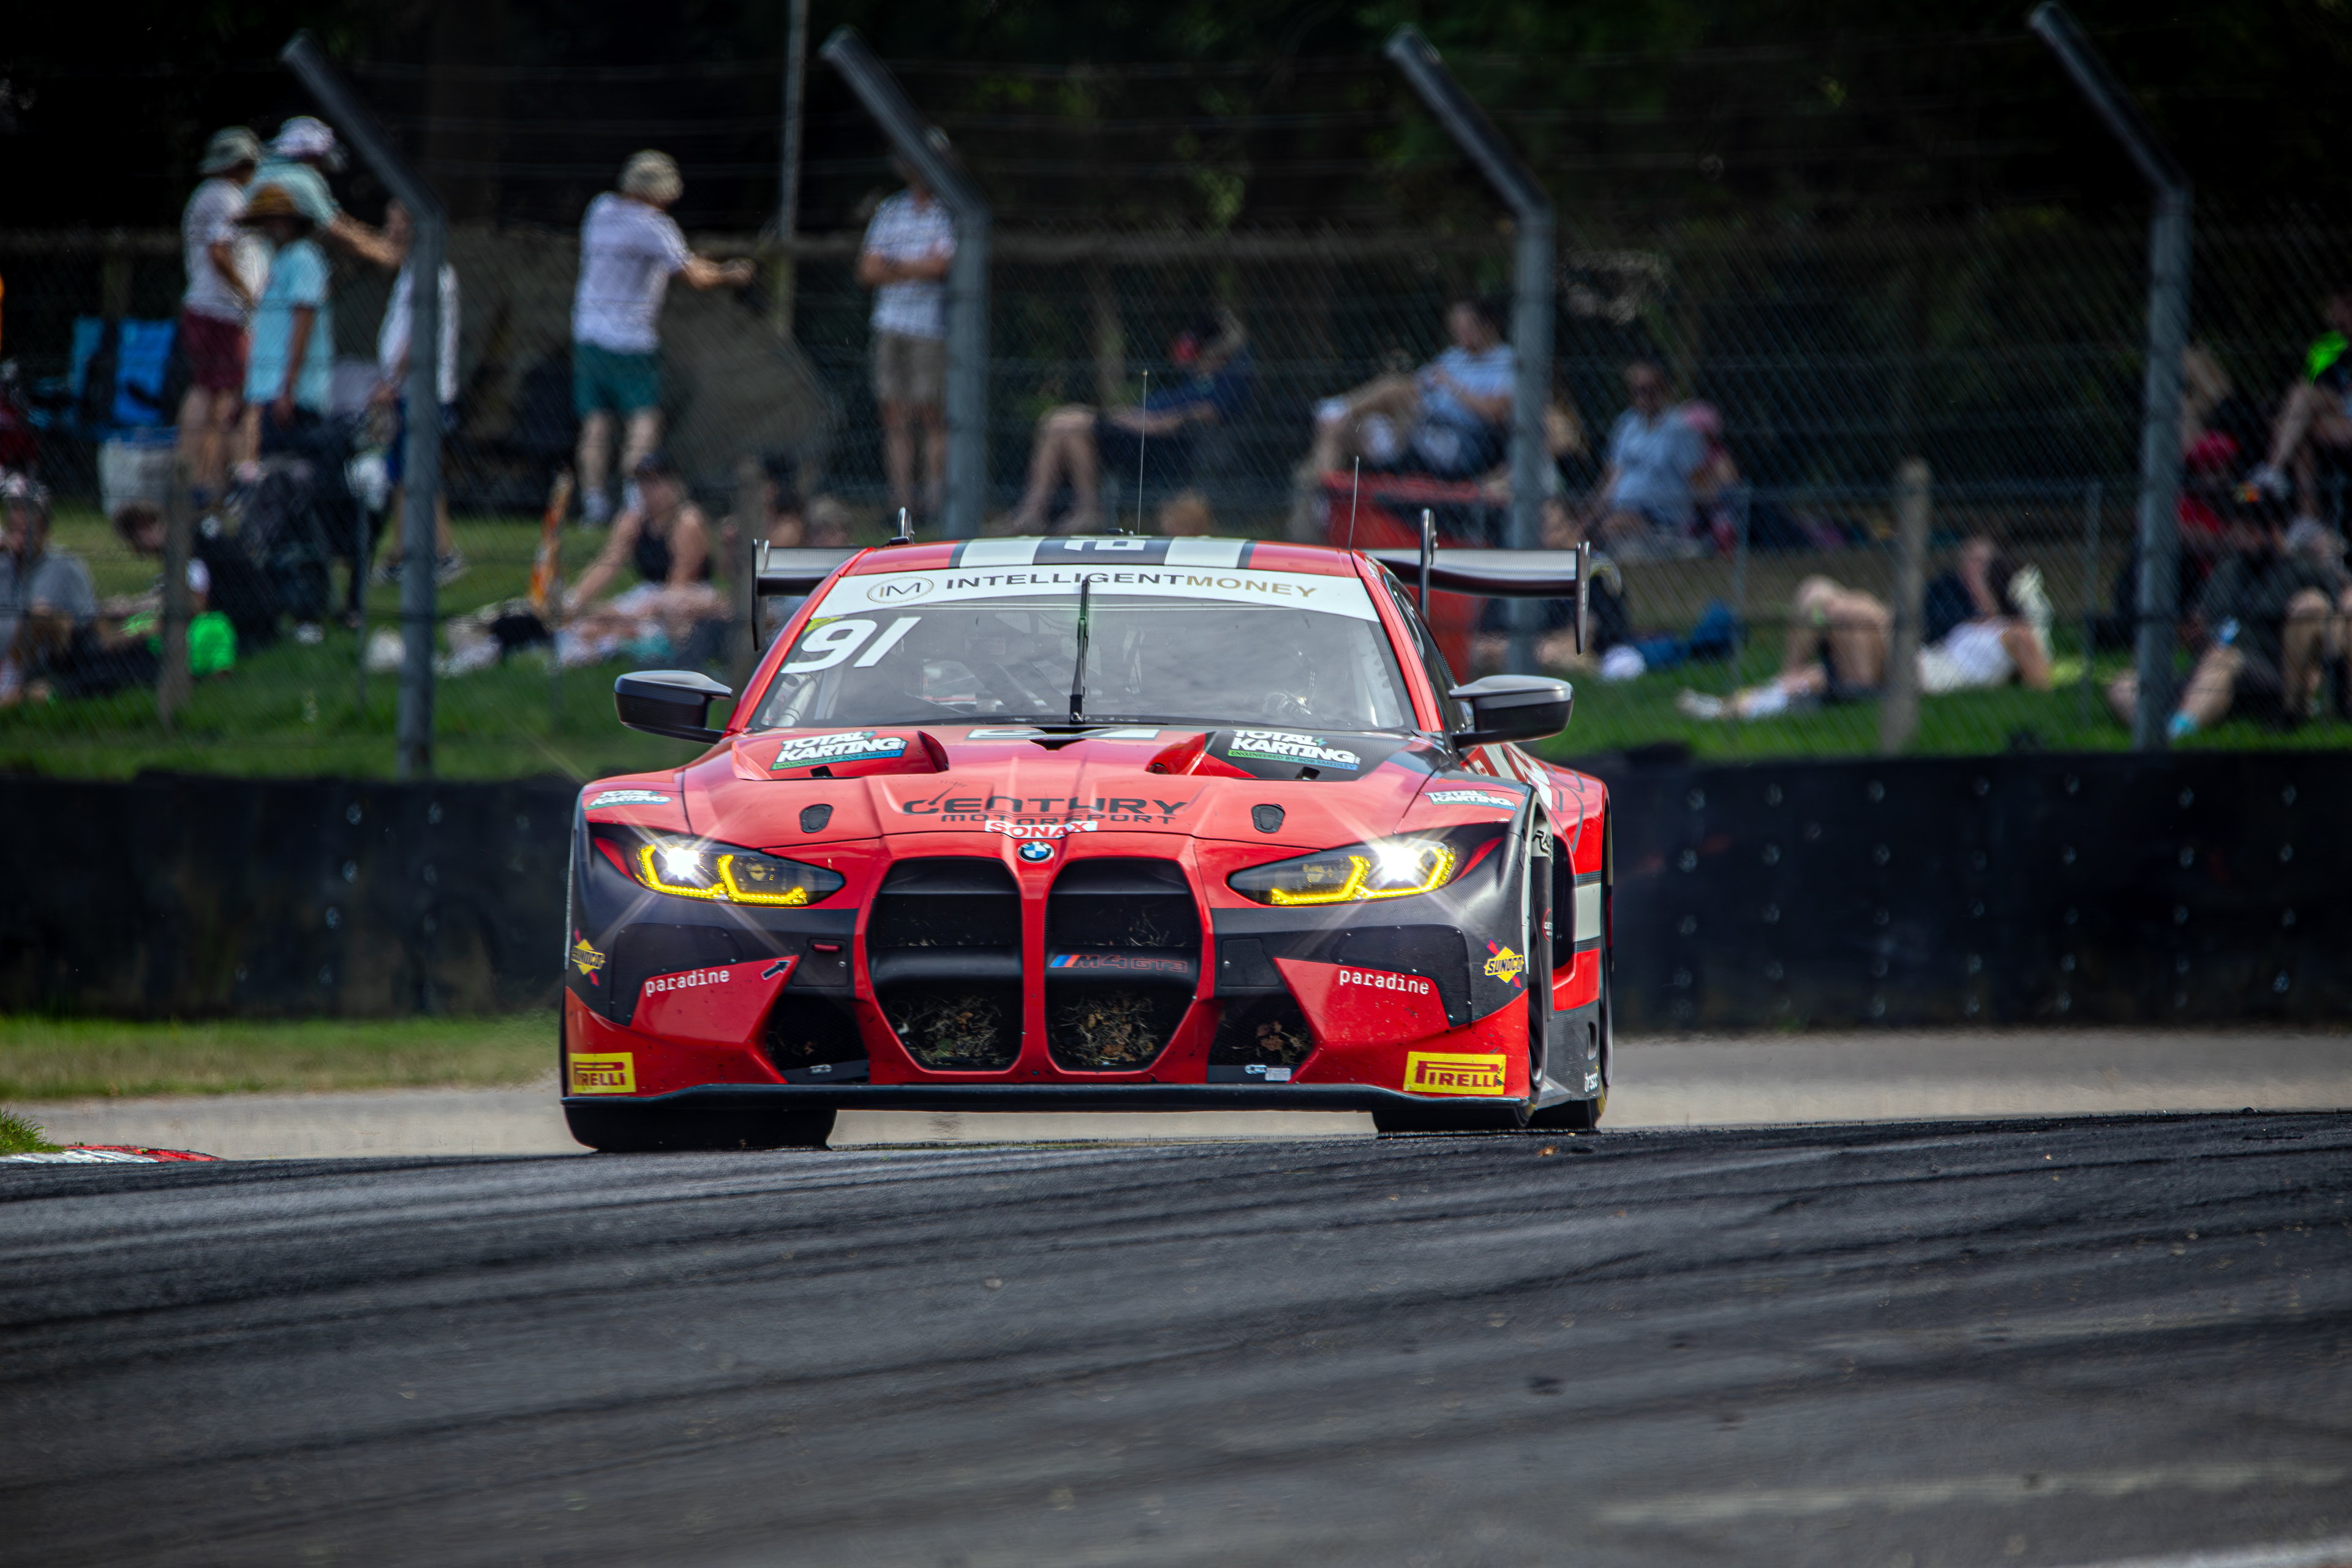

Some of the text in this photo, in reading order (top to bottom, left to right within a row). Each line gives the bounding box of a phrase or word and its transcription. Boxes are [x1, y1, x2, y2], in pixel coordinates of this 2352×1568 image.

[880, 582, 921, 597] IM
[780, 617, 922, 674] 91
[775, 737, 902, 763] KARTING
[782, 731, 866, 750] TOTAL
[1234, 730, 1317, 746] TOTAL
[1231, 737, 1355, 764] KARTING
[903, 791, 1188, 815] CENTURY
[1432, 796, 1511, 806] KARTING
[989, 822, 1088, 838] SONAX
[644, 969, 730, 997] paradine
[1339, 970, 1430, 995] paradine
[1415, 1060, 1499, 1088] PIRELLI
